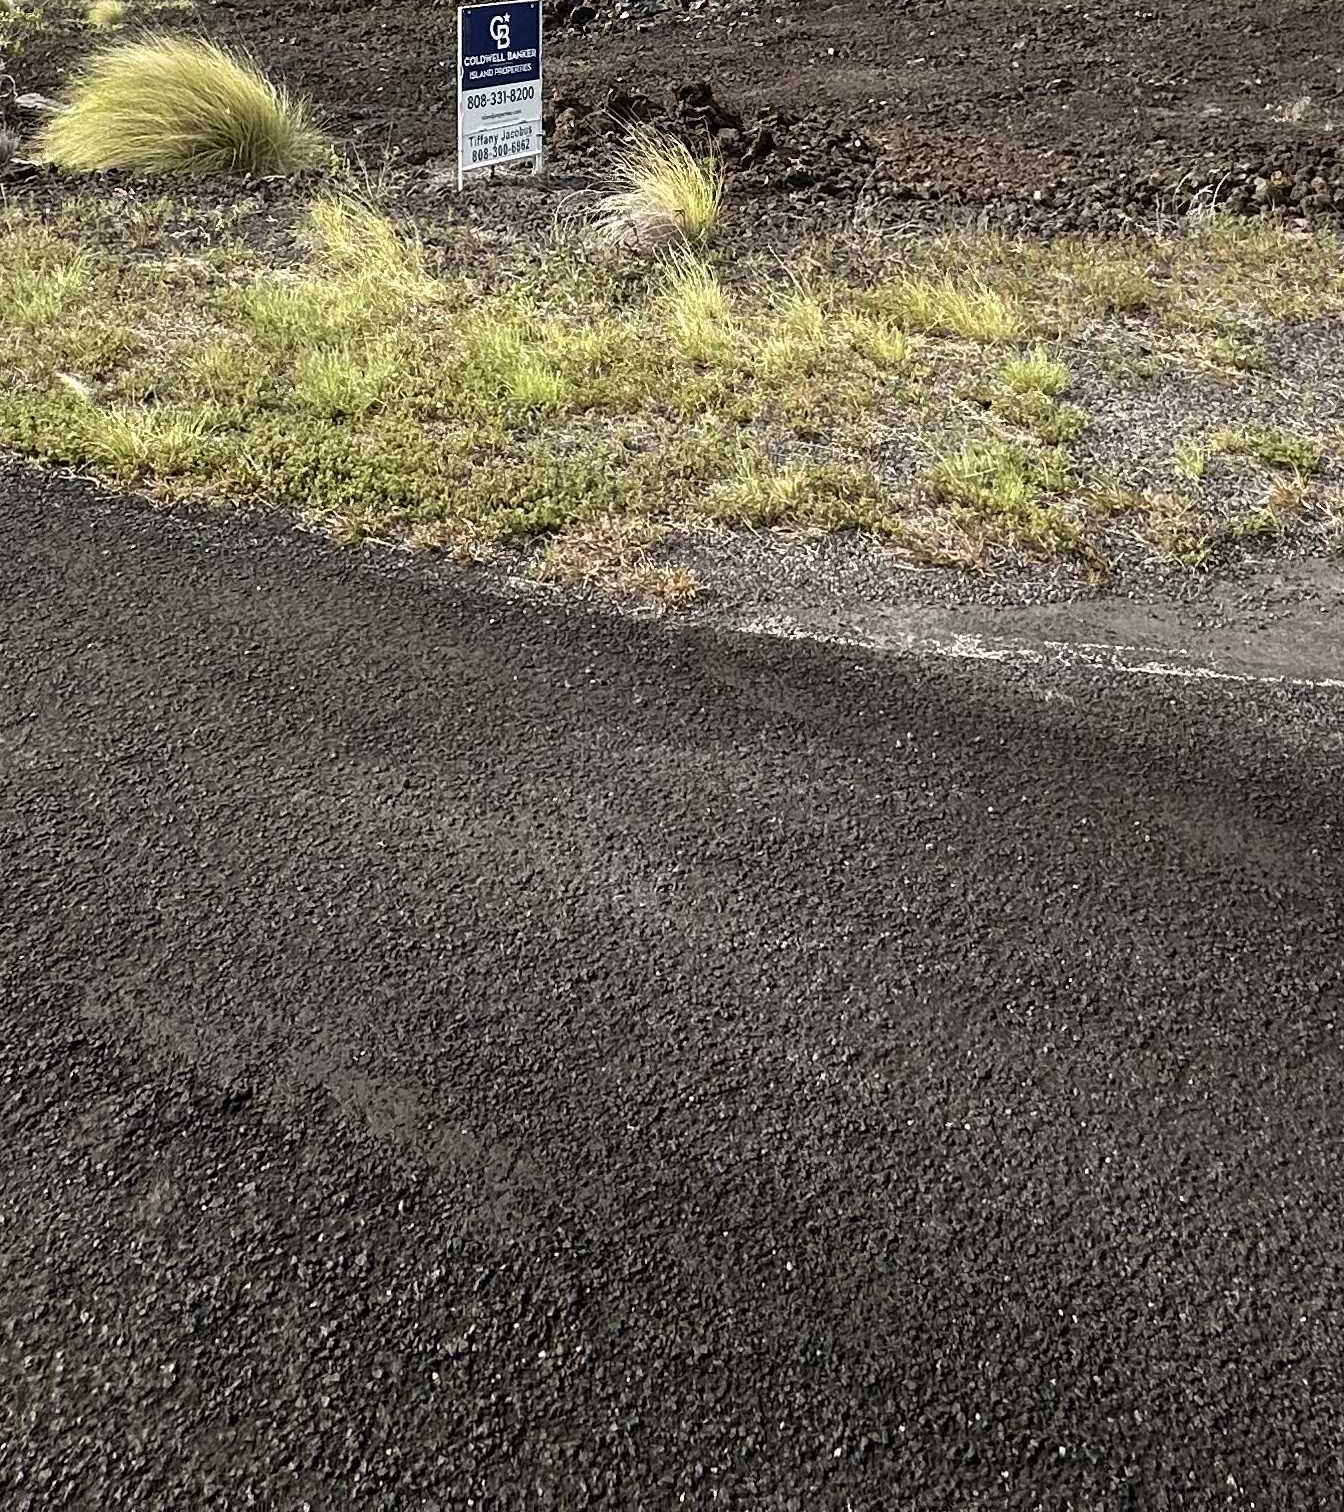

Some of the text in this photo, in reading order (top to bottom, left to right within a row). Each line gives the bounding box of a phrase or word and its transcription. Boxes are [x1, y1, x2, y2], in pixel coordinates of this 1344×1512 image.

[464, 49, 536, 66] COLDWELL BANKER
[469, 63, 532, 79] ISLAND PROPERTIES
[467, 86, 534, 109] 808-331-8200
[469, 126, 532, 149] Tiffany Jacobus
